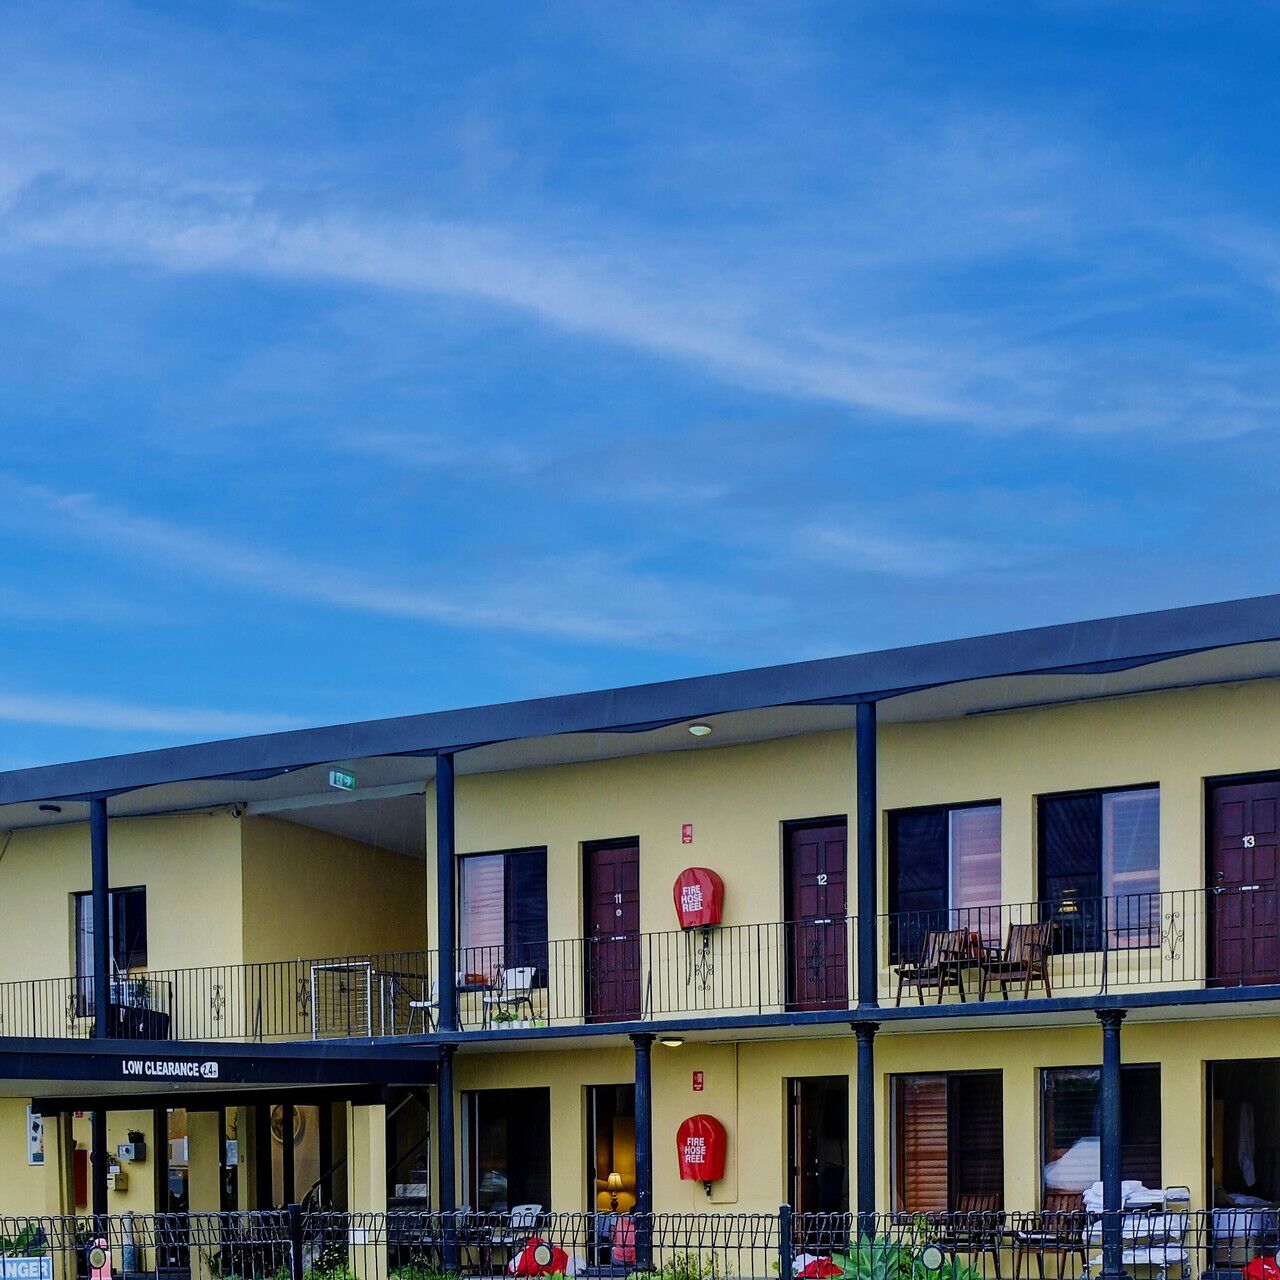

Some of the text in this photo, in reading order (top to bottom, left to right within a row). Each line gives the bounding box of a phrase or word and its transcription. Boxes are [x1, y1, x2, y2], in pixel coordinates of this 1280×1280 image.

[1242, 835, 1255, 848] 13
[816, 874, 828, 885] 12
[682, 885, 701, 895] FIRE
[614, 893, 622, 904] 11
[681, 893, 703, 904] HOSE
[682, 902, 703, 913] REEL
[122, 1060, 144, 1075] LOW
[145, 1061, 200, 1077] CLEARANCE
[687, 1137, 705, 1146] FIRE
[684, 1146, 706, 1155] HOSE
[685, 1154, 705, 1163] REEL
